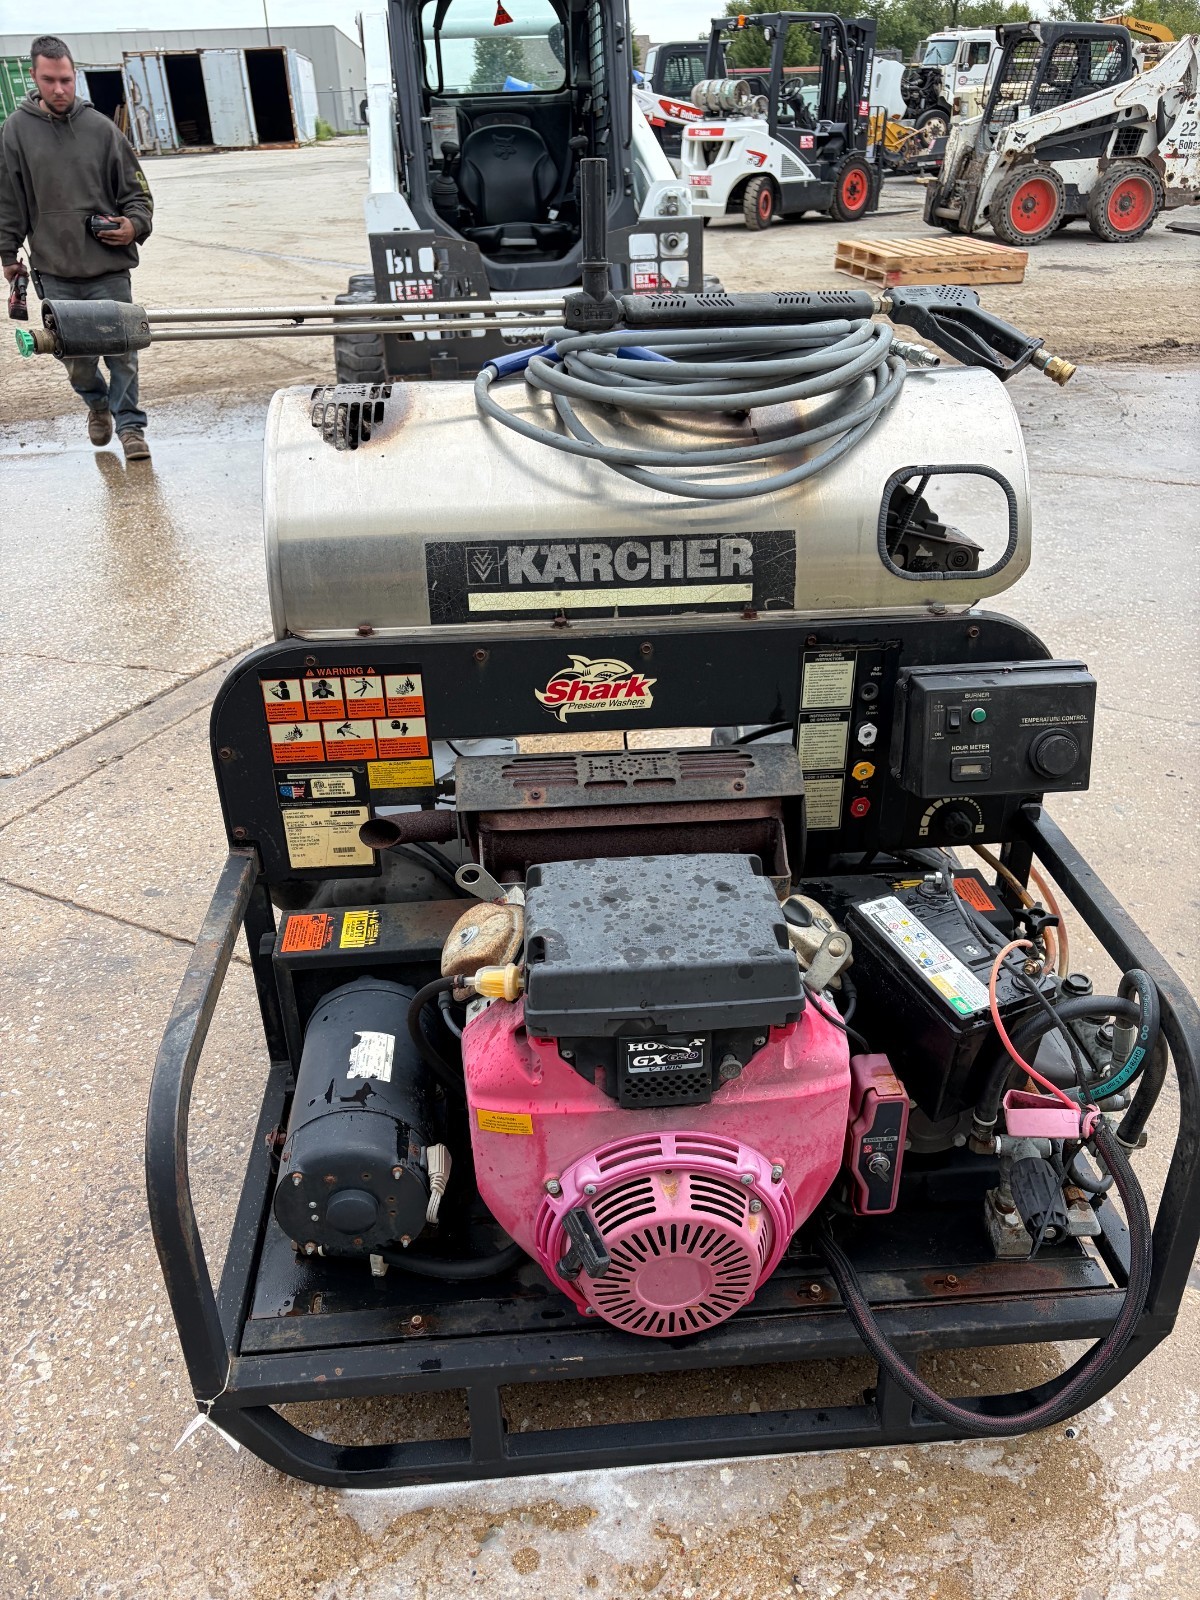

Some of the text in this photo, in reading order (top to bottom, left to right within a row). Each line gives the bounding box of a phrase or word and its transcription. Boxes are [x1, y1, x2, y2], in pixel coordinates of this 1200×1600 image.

[507, 538, 754, 585] KÄRCHER
[316, 667, 364, 676] WARNING
[544, 676, 650, 703] Shark
[568, 698, 646, 710] Pressure Washers
[1021, 716, 1061, 724] TEMPERATURE
[1061, 714, 1088, 722] CONTROL
[587, 756, 667, 778] HOT
[354, 919, 366, 938] HOT!
